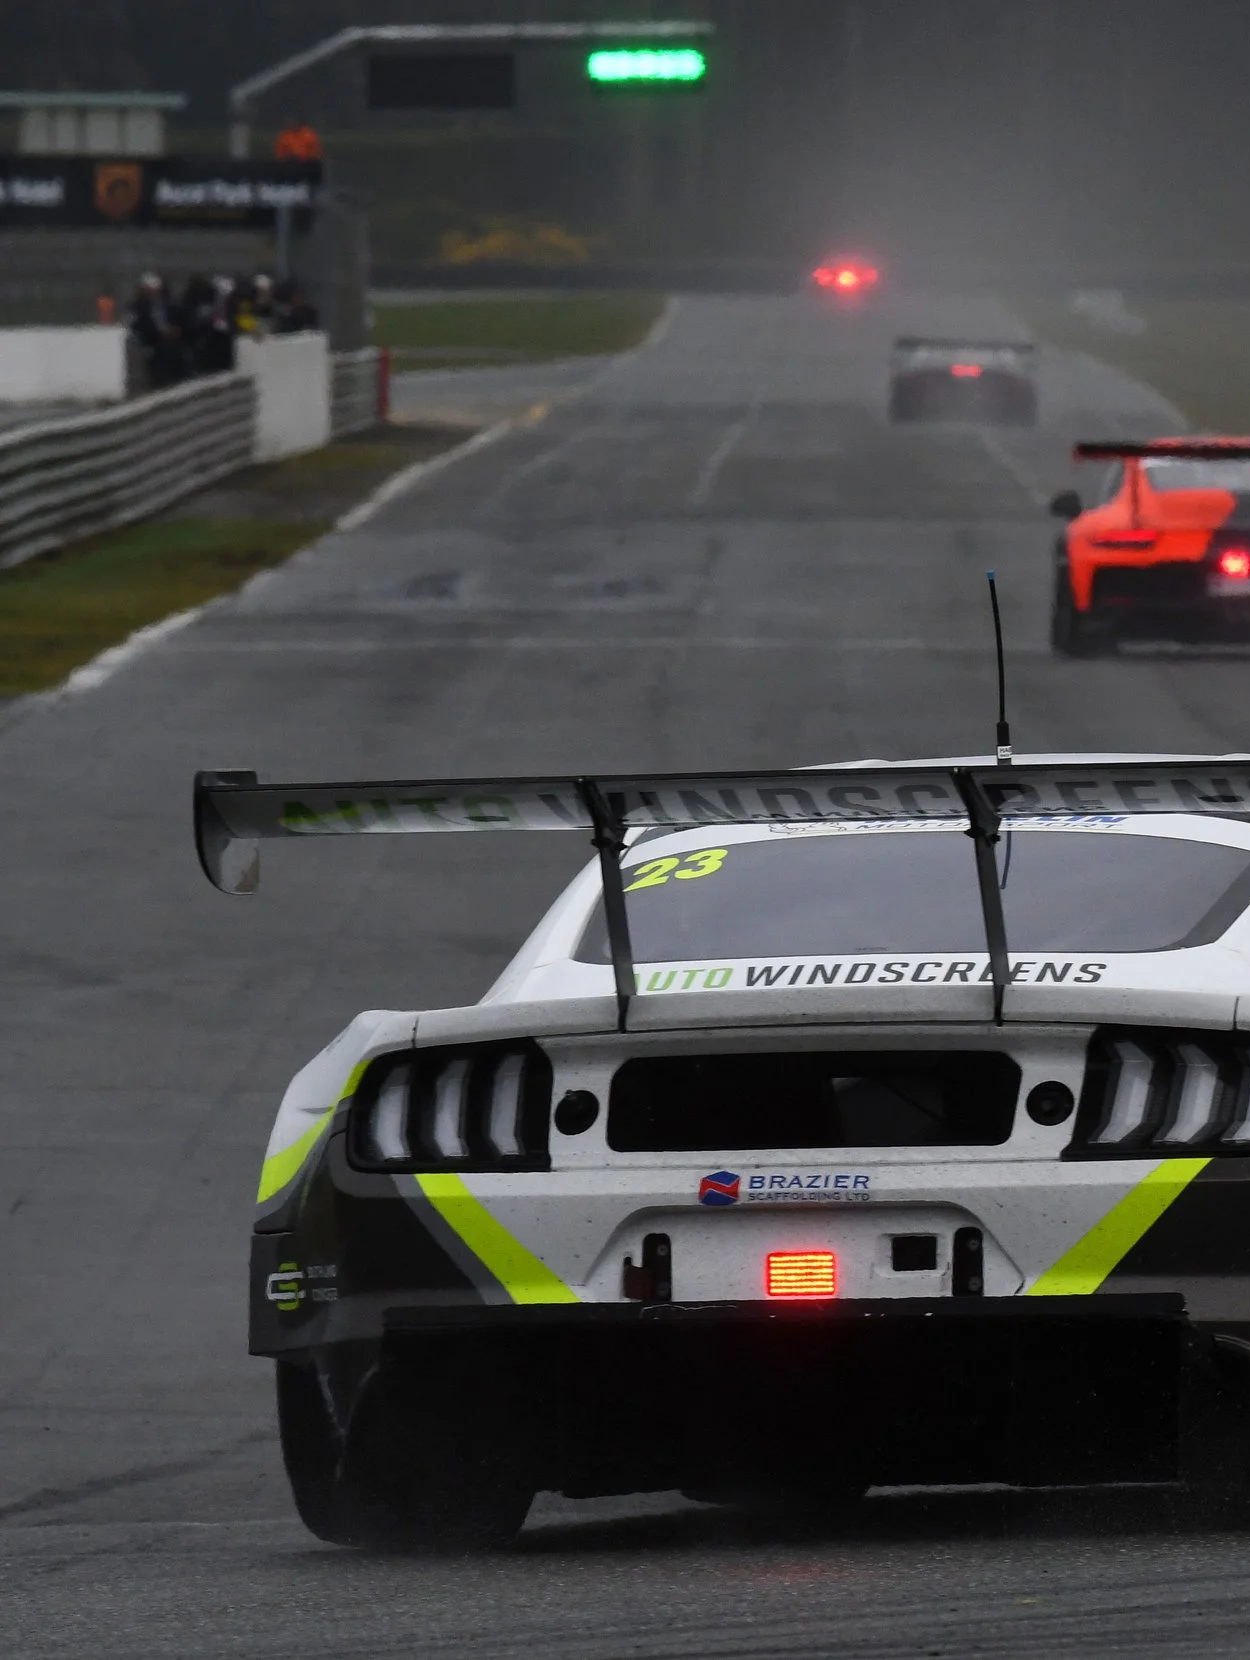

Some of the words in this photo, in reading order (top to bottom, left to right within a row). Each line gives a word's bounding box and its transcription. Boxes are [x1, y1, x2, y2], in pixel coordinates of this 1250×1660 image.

[622, 849, 728, 892] 23
[633, 967, 734, 993] UTO
[745, 961, 1107, 987] WINDSCREENS
[748, 1175, 870, 1189] BRAZIER
[748, 1192, 841, 1201] SCAFFOLDING
[847, 1192, 870, 1201] LTD
